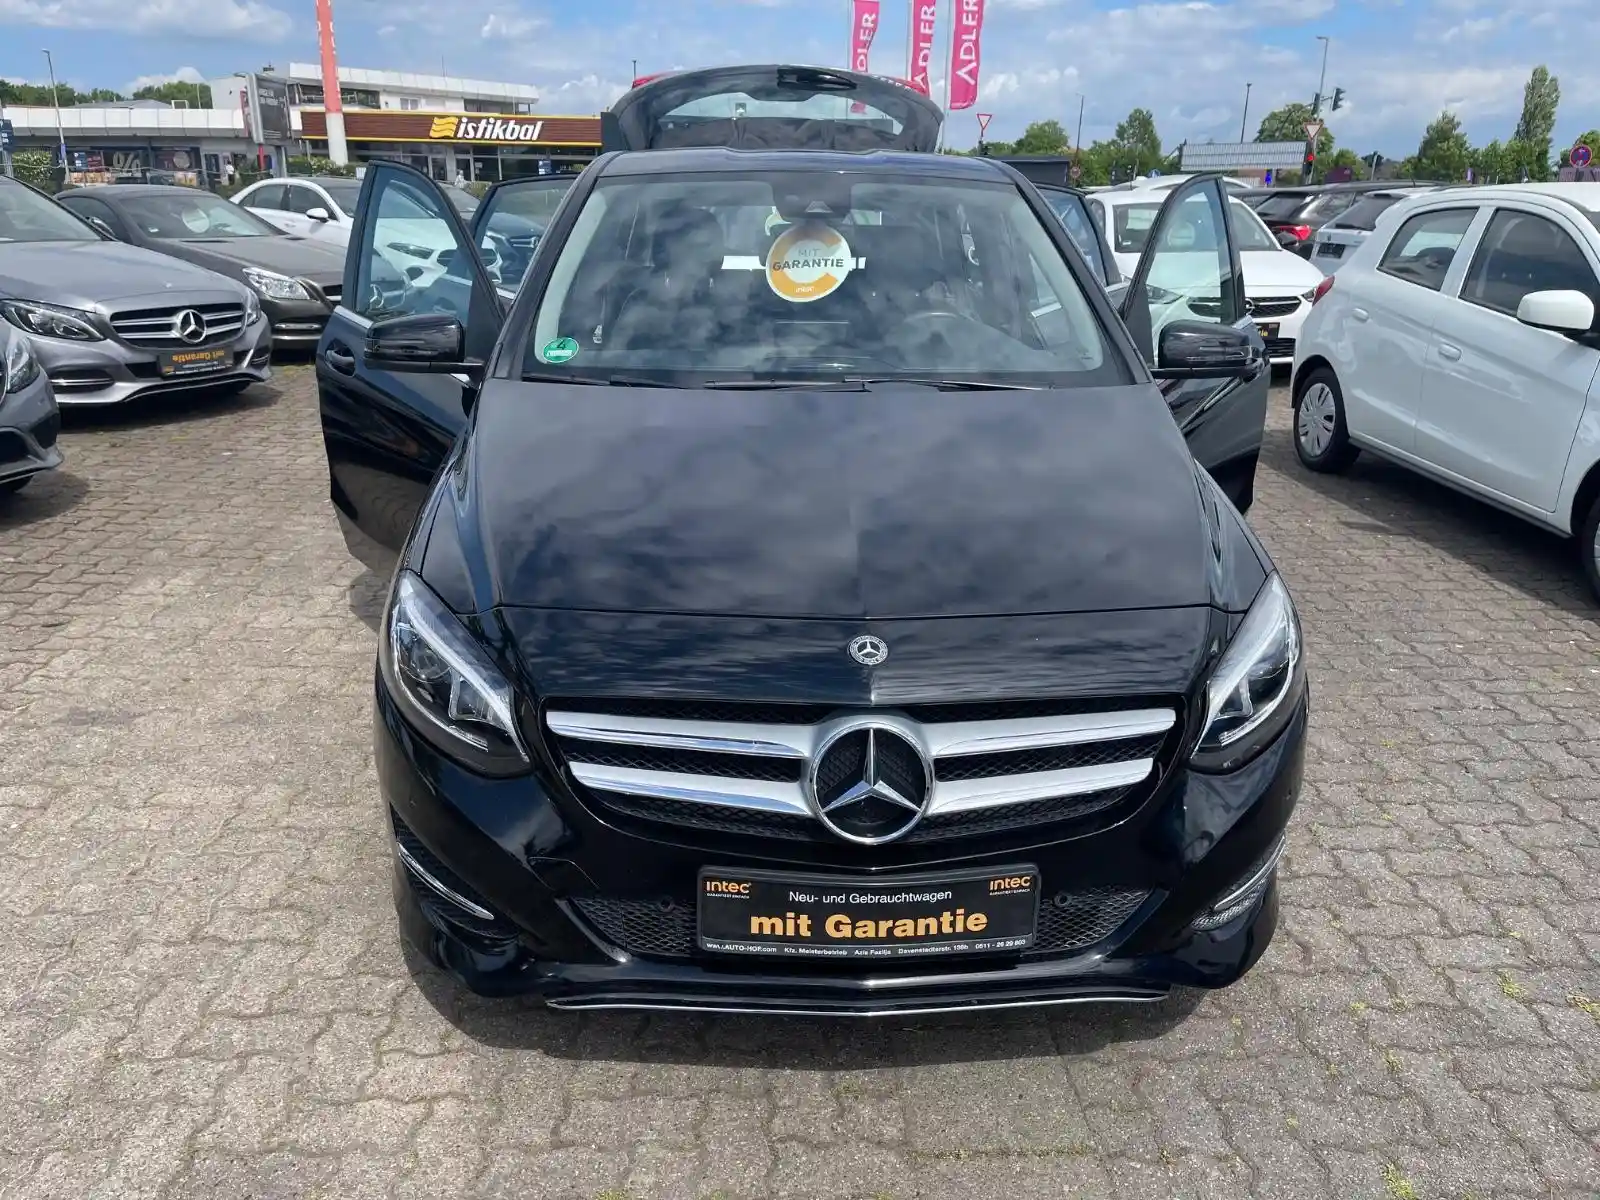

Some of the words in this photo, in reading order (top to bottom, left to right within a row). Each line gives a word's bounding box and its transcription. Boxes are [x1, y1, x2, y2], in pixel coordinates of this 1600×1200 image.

[856, 13, 876, 72] DLER
[913, 5, 936, 89] ADLER
[955, 0, 979, 86] ADLER
[456, 117, 544, 141] istikbal
[798, 248, 821, 257] MIT
[772, 258, 844, 271] GARANTIE
[706, 880, 751, 894] intec
[989, 876, 1031, 891] intec
[789, 891, 819, 903] Neu-
[822, 893, 846, 904] und
[849, 890, 952, 904] Gebrauchtwagen
[750, 911, 812, 937] mit
[824, 908, 988, 938] Garantie
